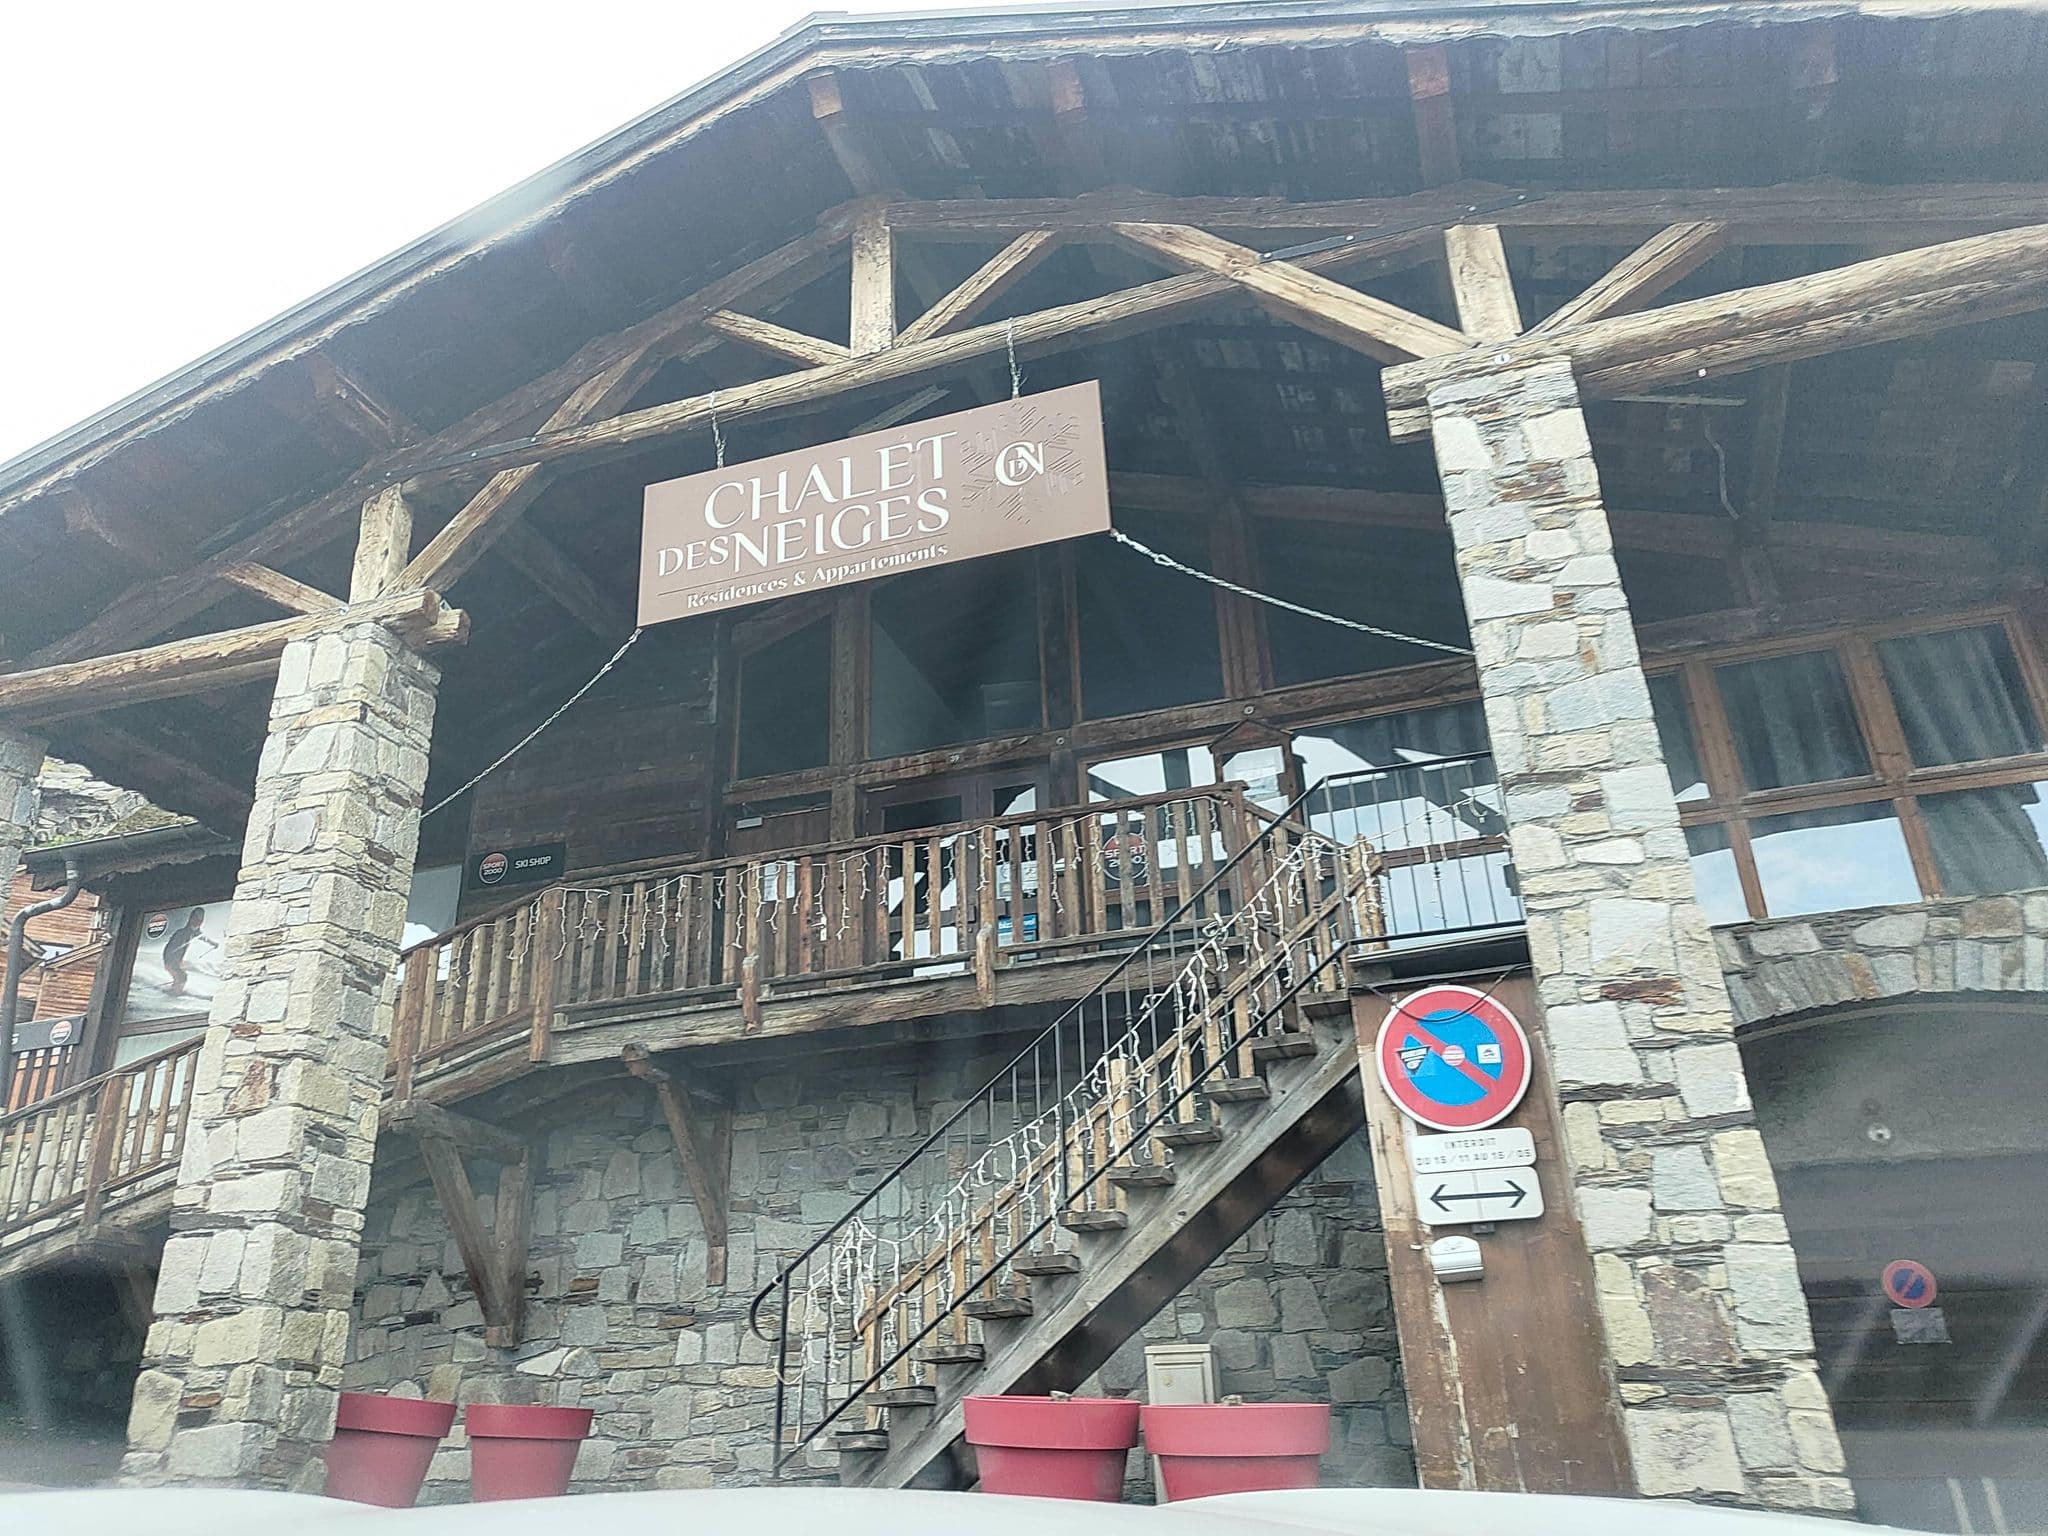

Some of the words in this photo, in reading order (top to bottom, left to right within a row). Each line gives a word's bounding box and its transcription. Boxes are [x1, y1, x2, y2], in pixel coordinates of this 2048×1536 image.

[704, 432, 958, 529] CHALET
[658, 536, 729, 577] DES
[731, 487, 950, 573] NEIGES
[687, 577, 788, 609] Résidences
[793, 570, 807, 587] &
[812, 543, 949, 583] Appartements
[483, 860, 505, 869] SPORT
[515, 859, 528, 869] SKI
[529, 855, 551, 866] SHOP
[1444, 1137, 1497, 1150] INTERDIT
